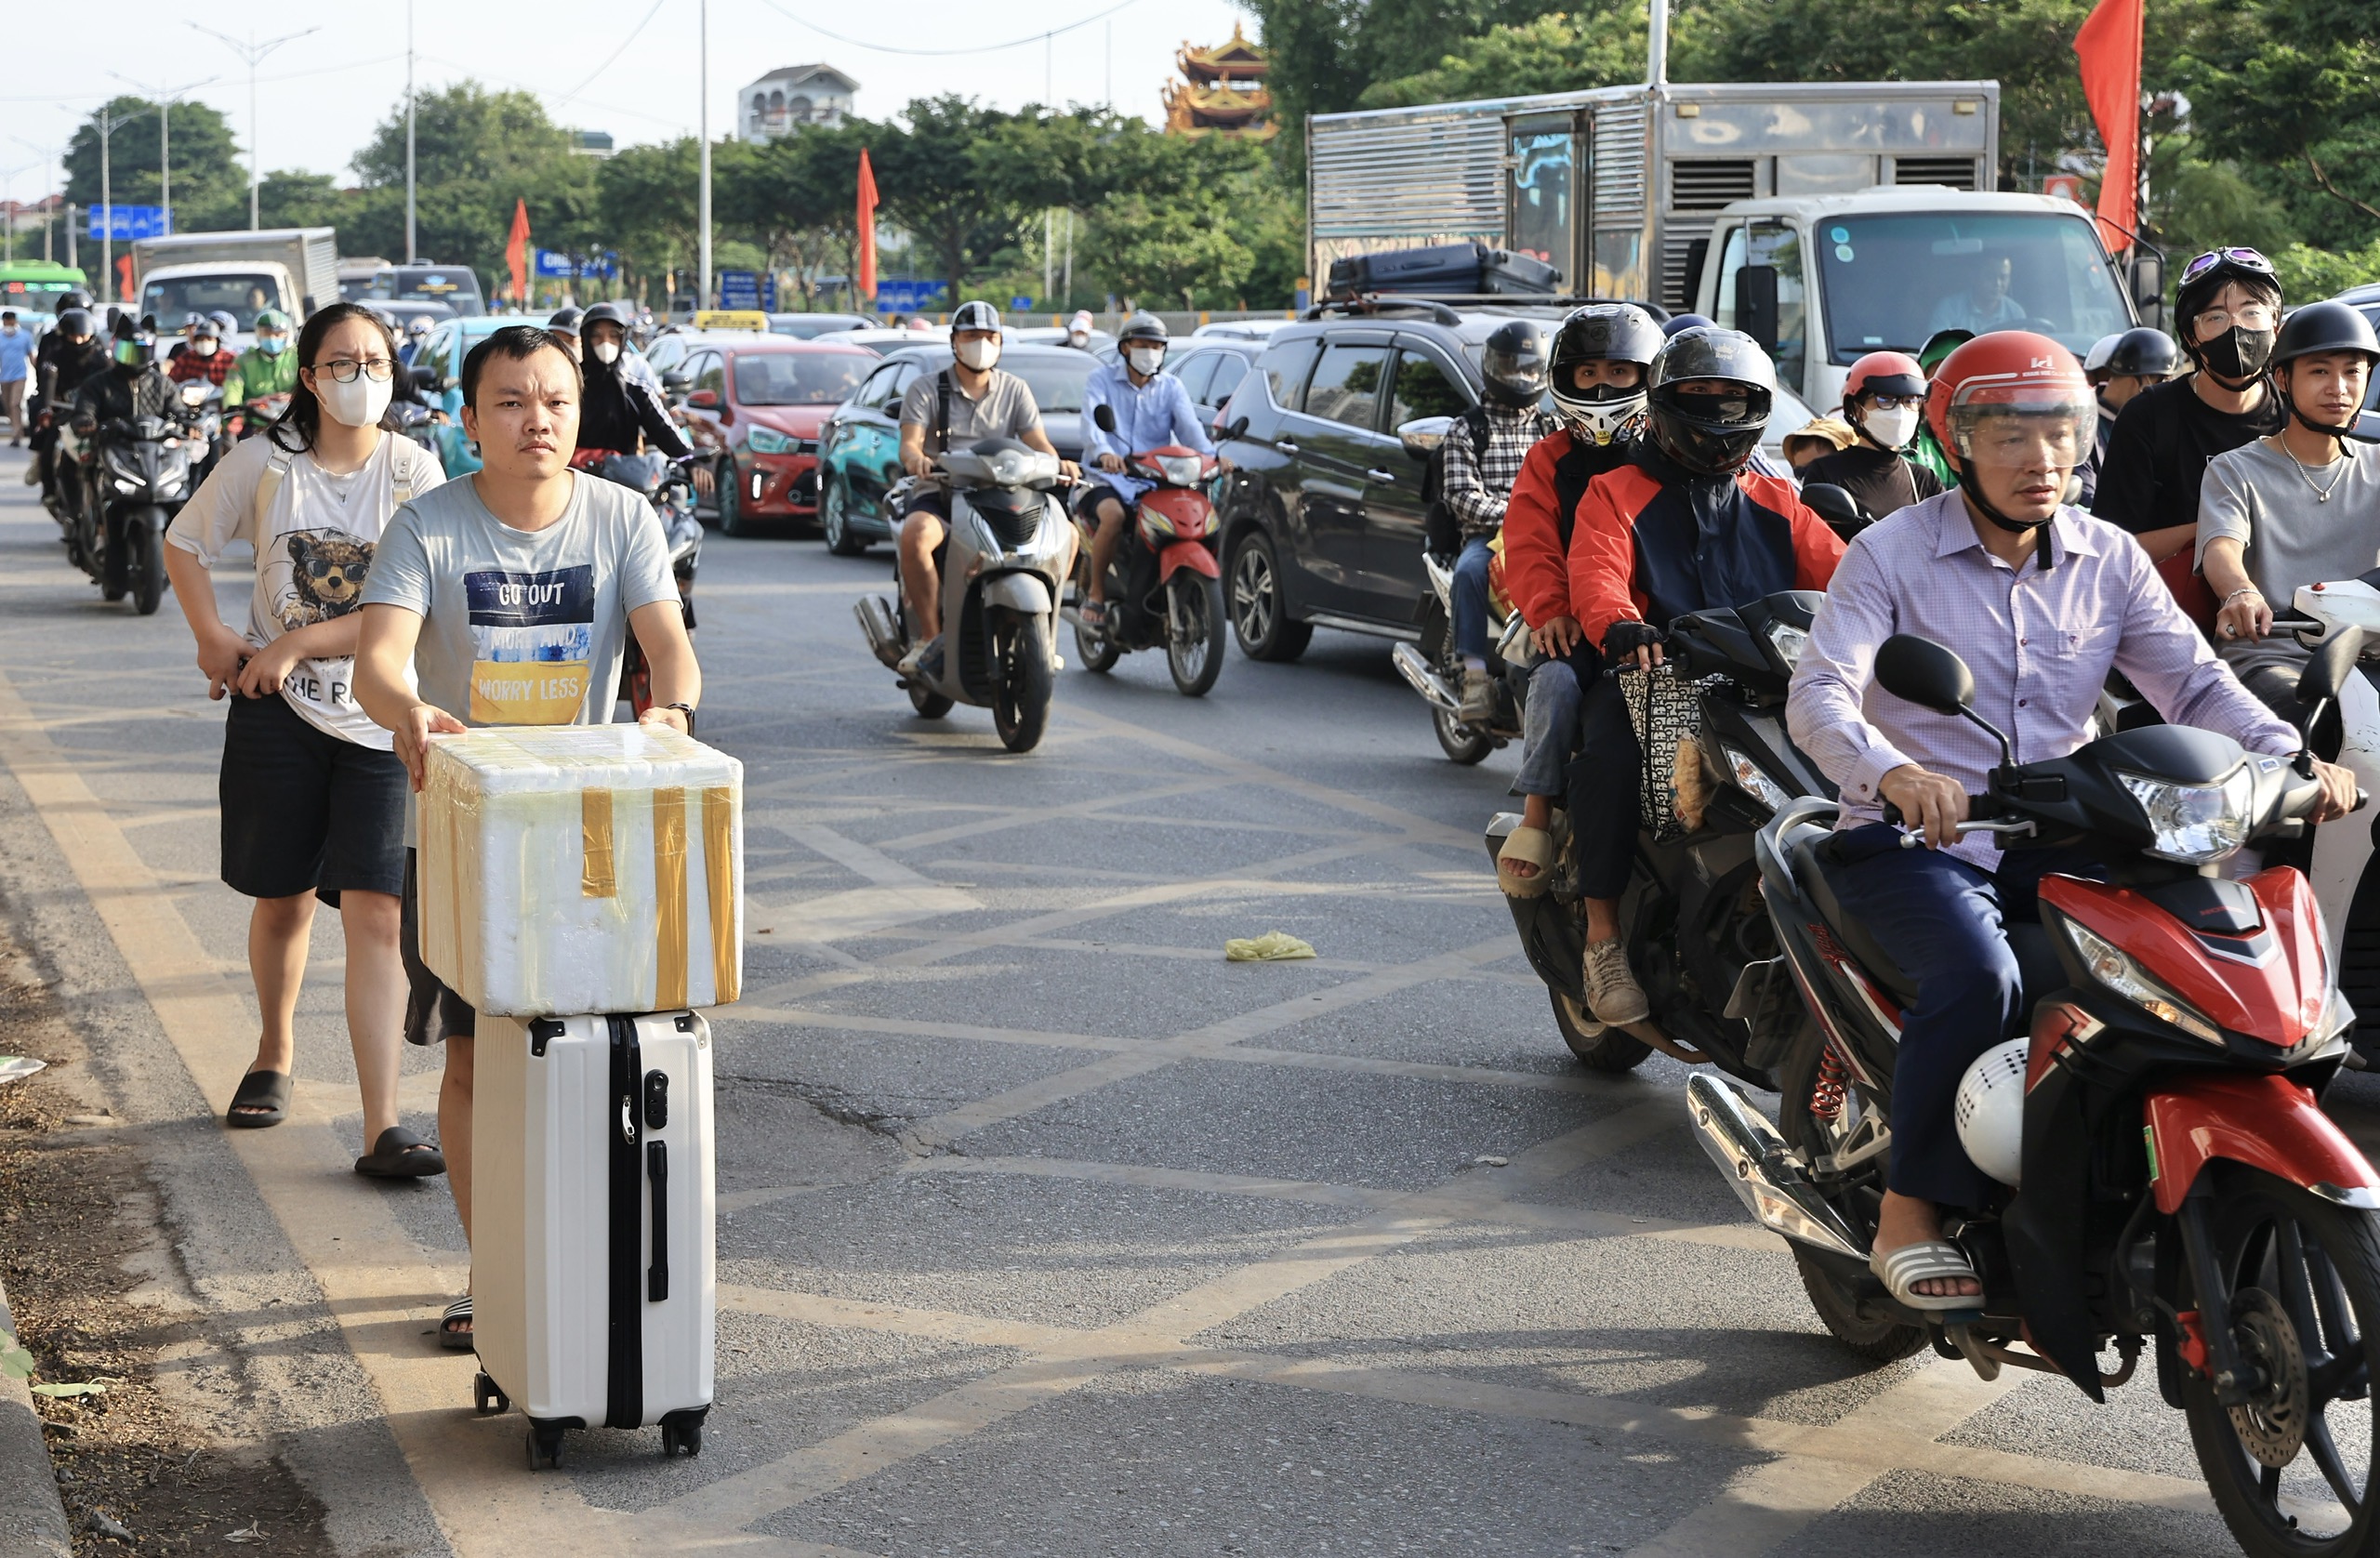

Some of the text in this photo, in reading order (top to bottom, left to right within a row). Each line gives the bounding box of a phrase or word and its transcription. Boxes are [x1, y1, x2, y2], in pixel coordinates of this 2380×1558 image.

[1715, 352, 1733, 361] Royal
[499, 582, 565, 606] GO OUT
[491, 626, 576, 650] MORE AND
[284, 677, 354, 704] HE R
[479, 677, 579, 701] WORRY LESS
